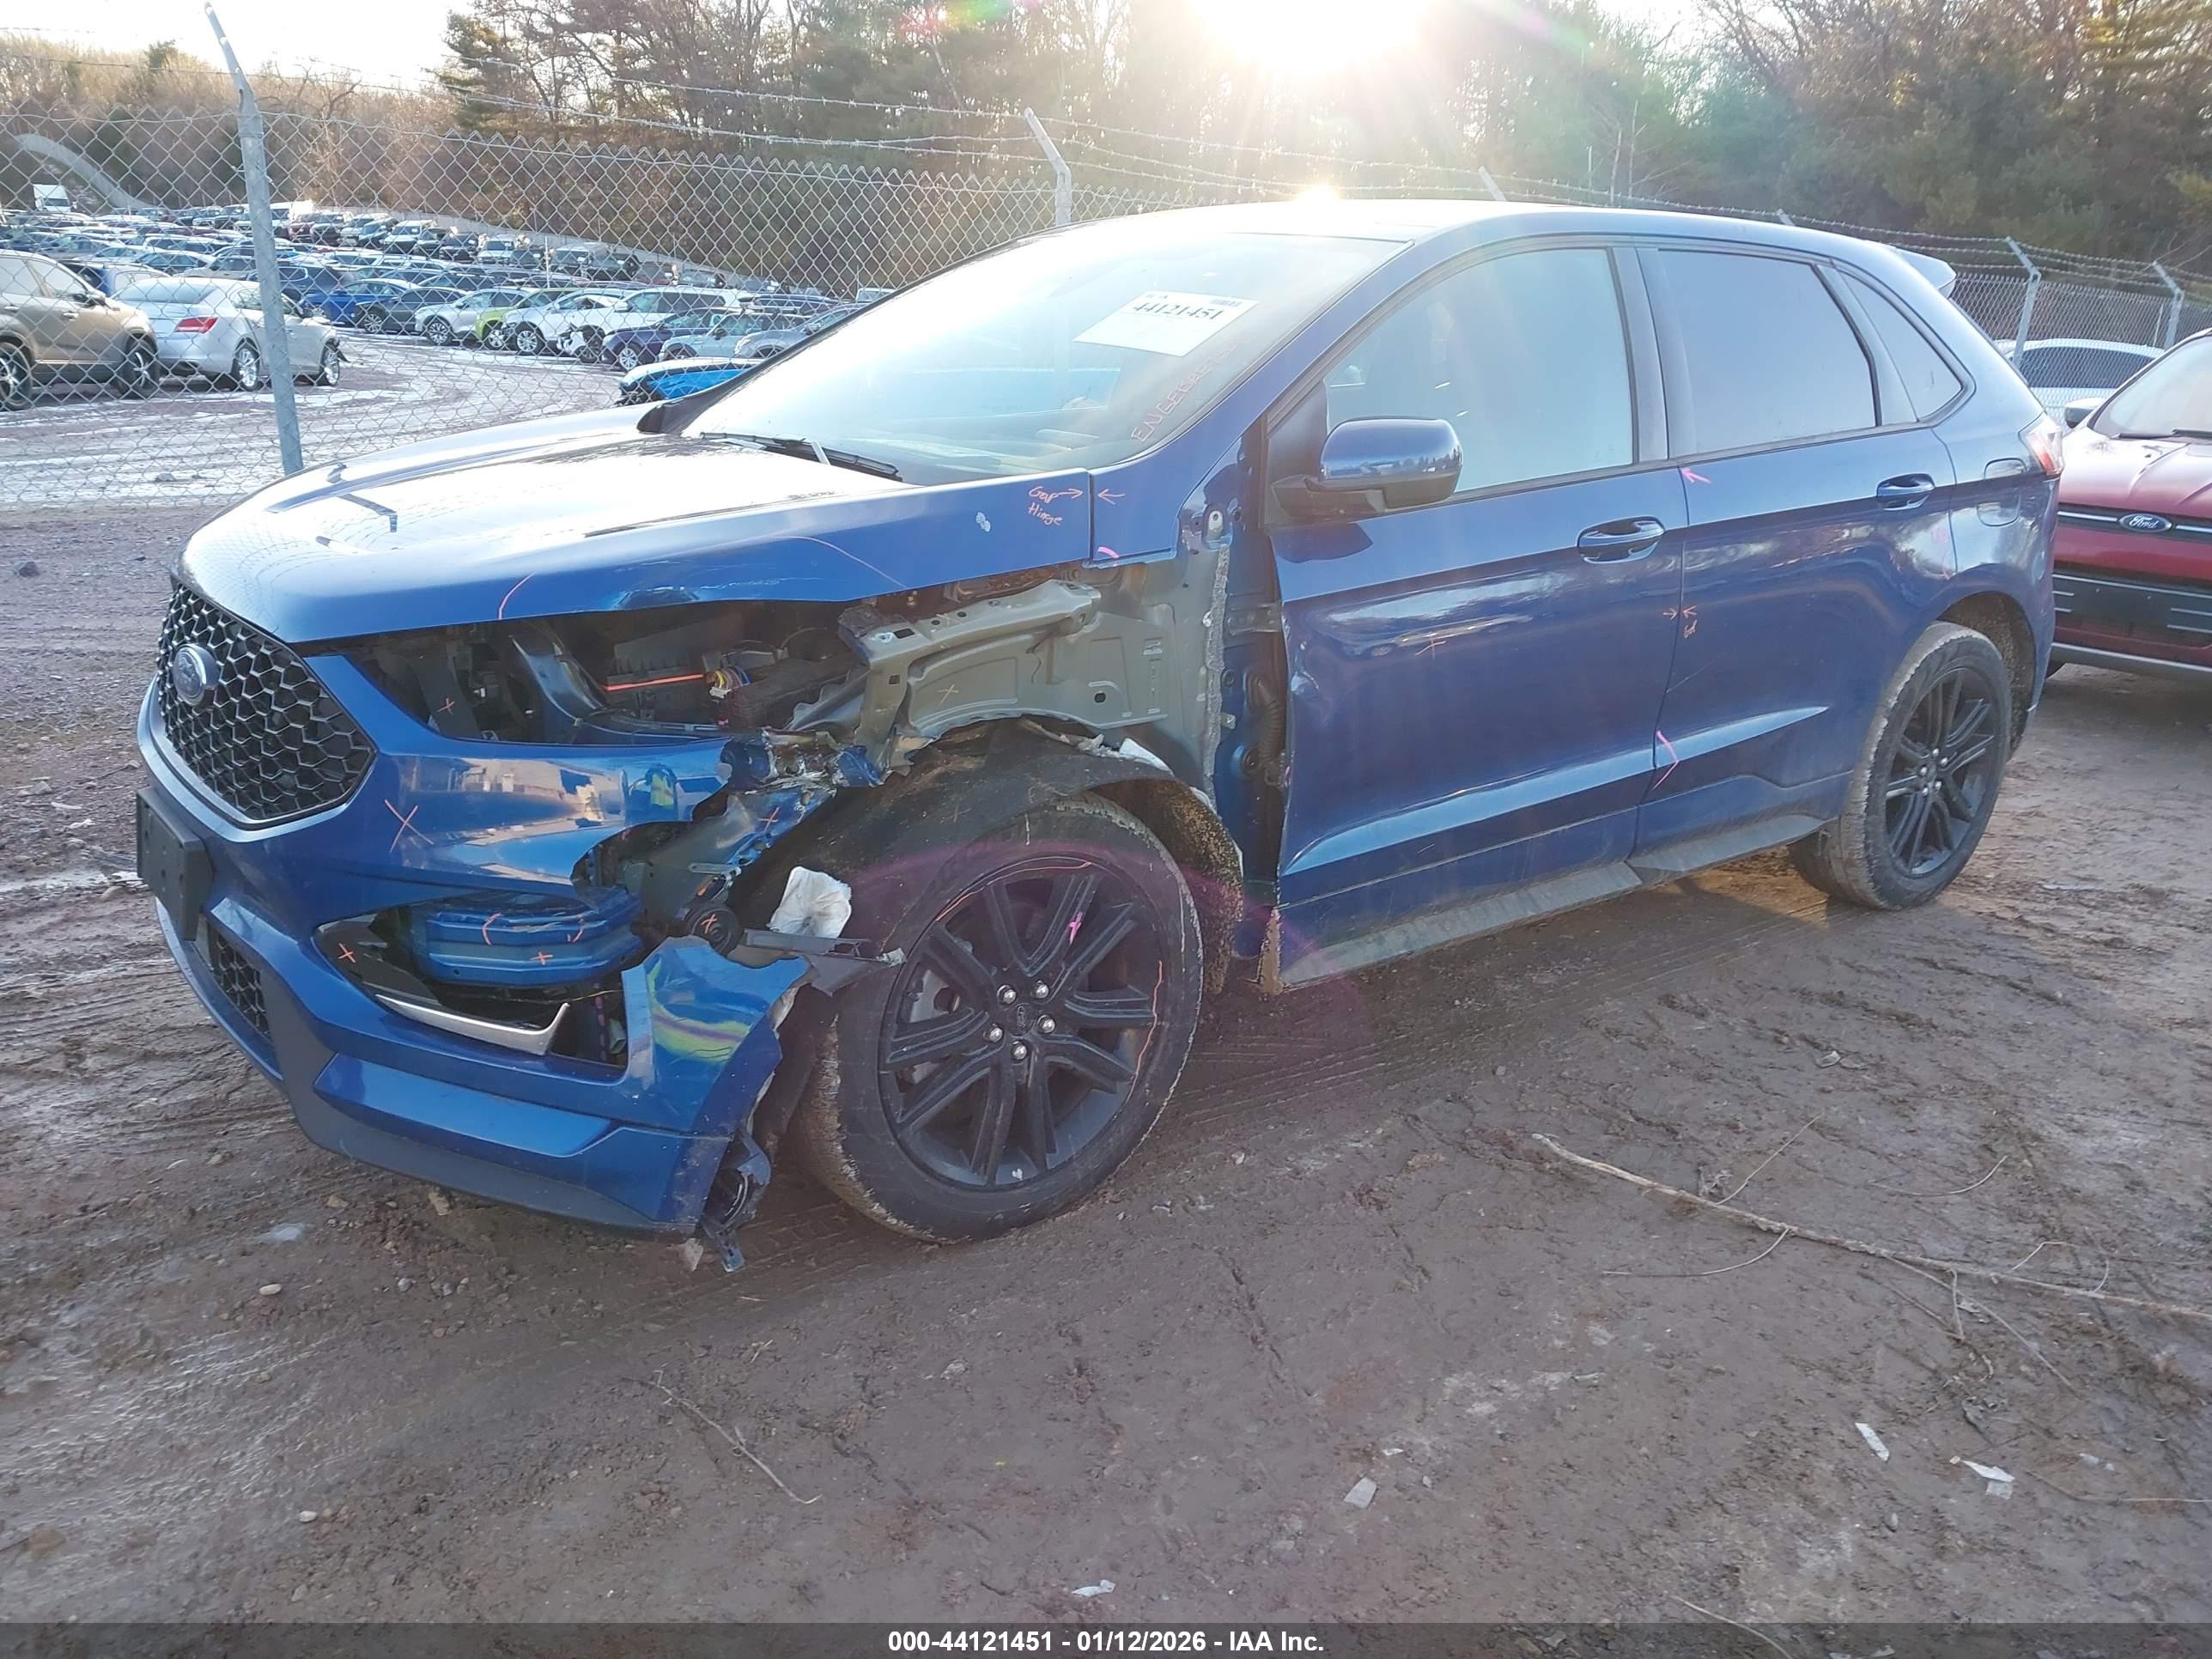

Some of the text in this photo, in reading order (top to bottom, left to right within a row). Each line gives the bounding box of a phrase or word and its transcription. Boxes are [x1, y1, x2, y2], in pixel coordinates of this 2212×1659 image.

[1133, 302, 1224, 320] 44121451
[1028, 502, 1063, 526] Hinge
[2129, 515, 2159, 529] Ford
